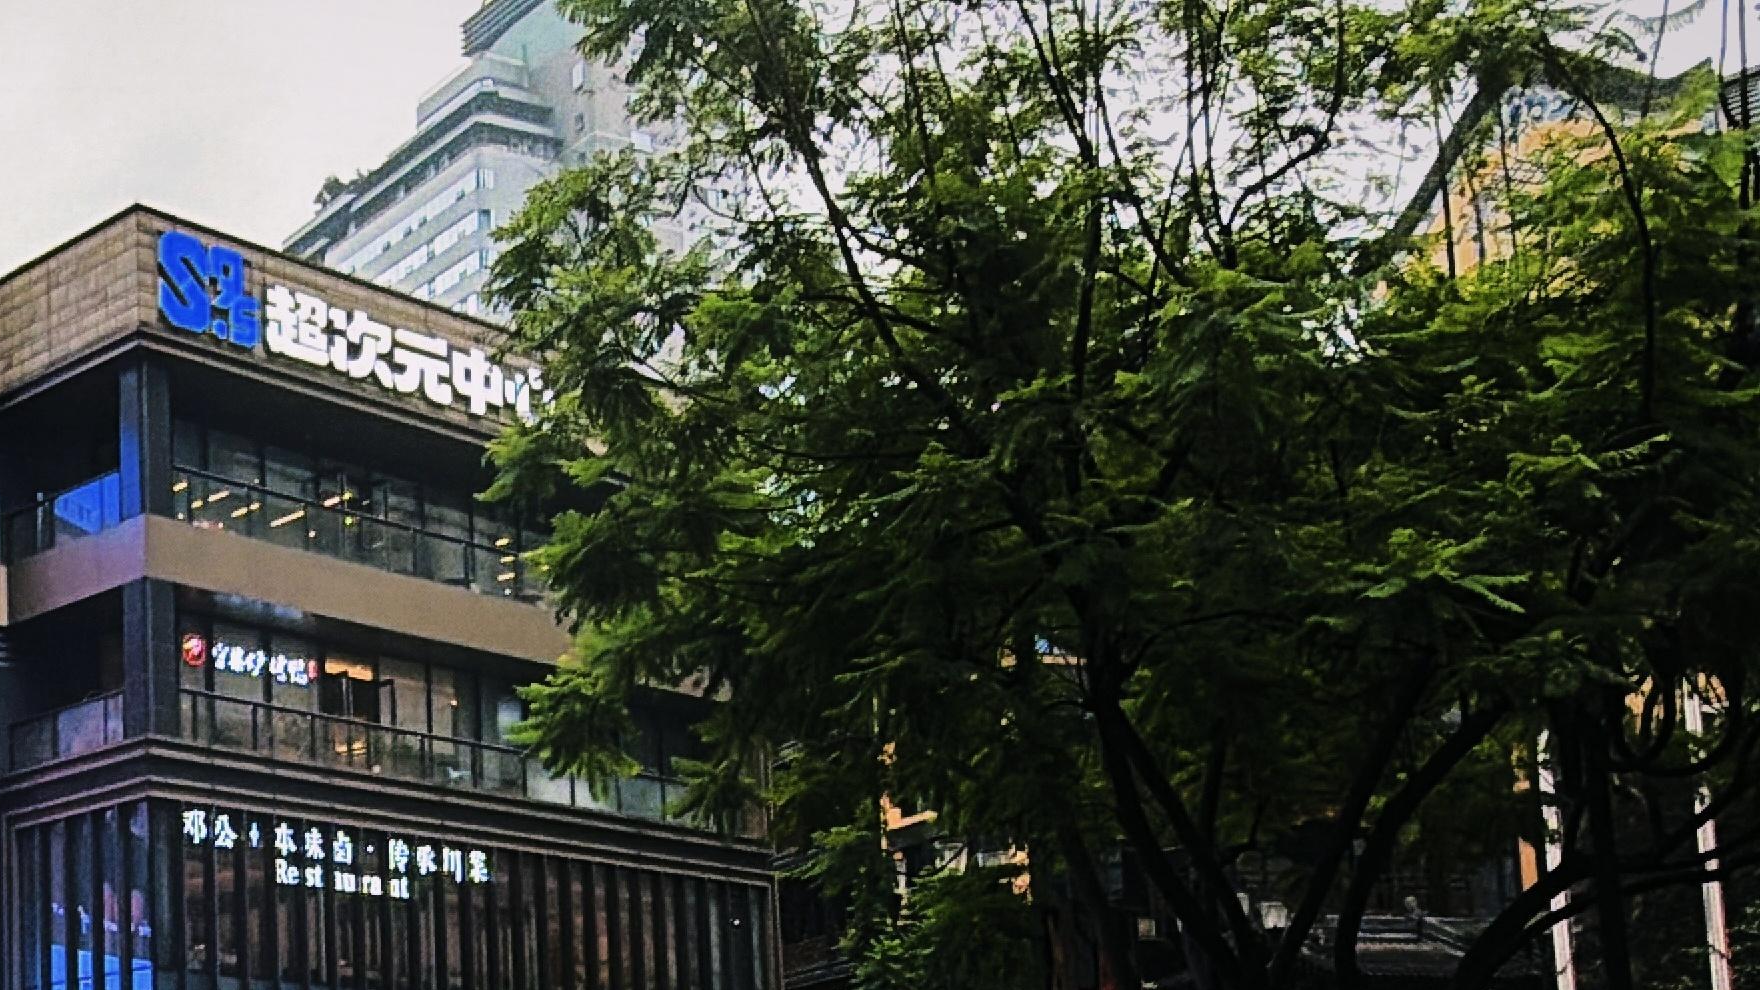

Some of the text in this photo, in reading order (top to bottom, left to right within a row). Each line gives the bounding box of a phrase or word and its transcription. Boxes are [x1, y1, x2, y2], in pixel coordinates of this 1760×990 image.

[265, 284, 558, 428] 超次元中心
